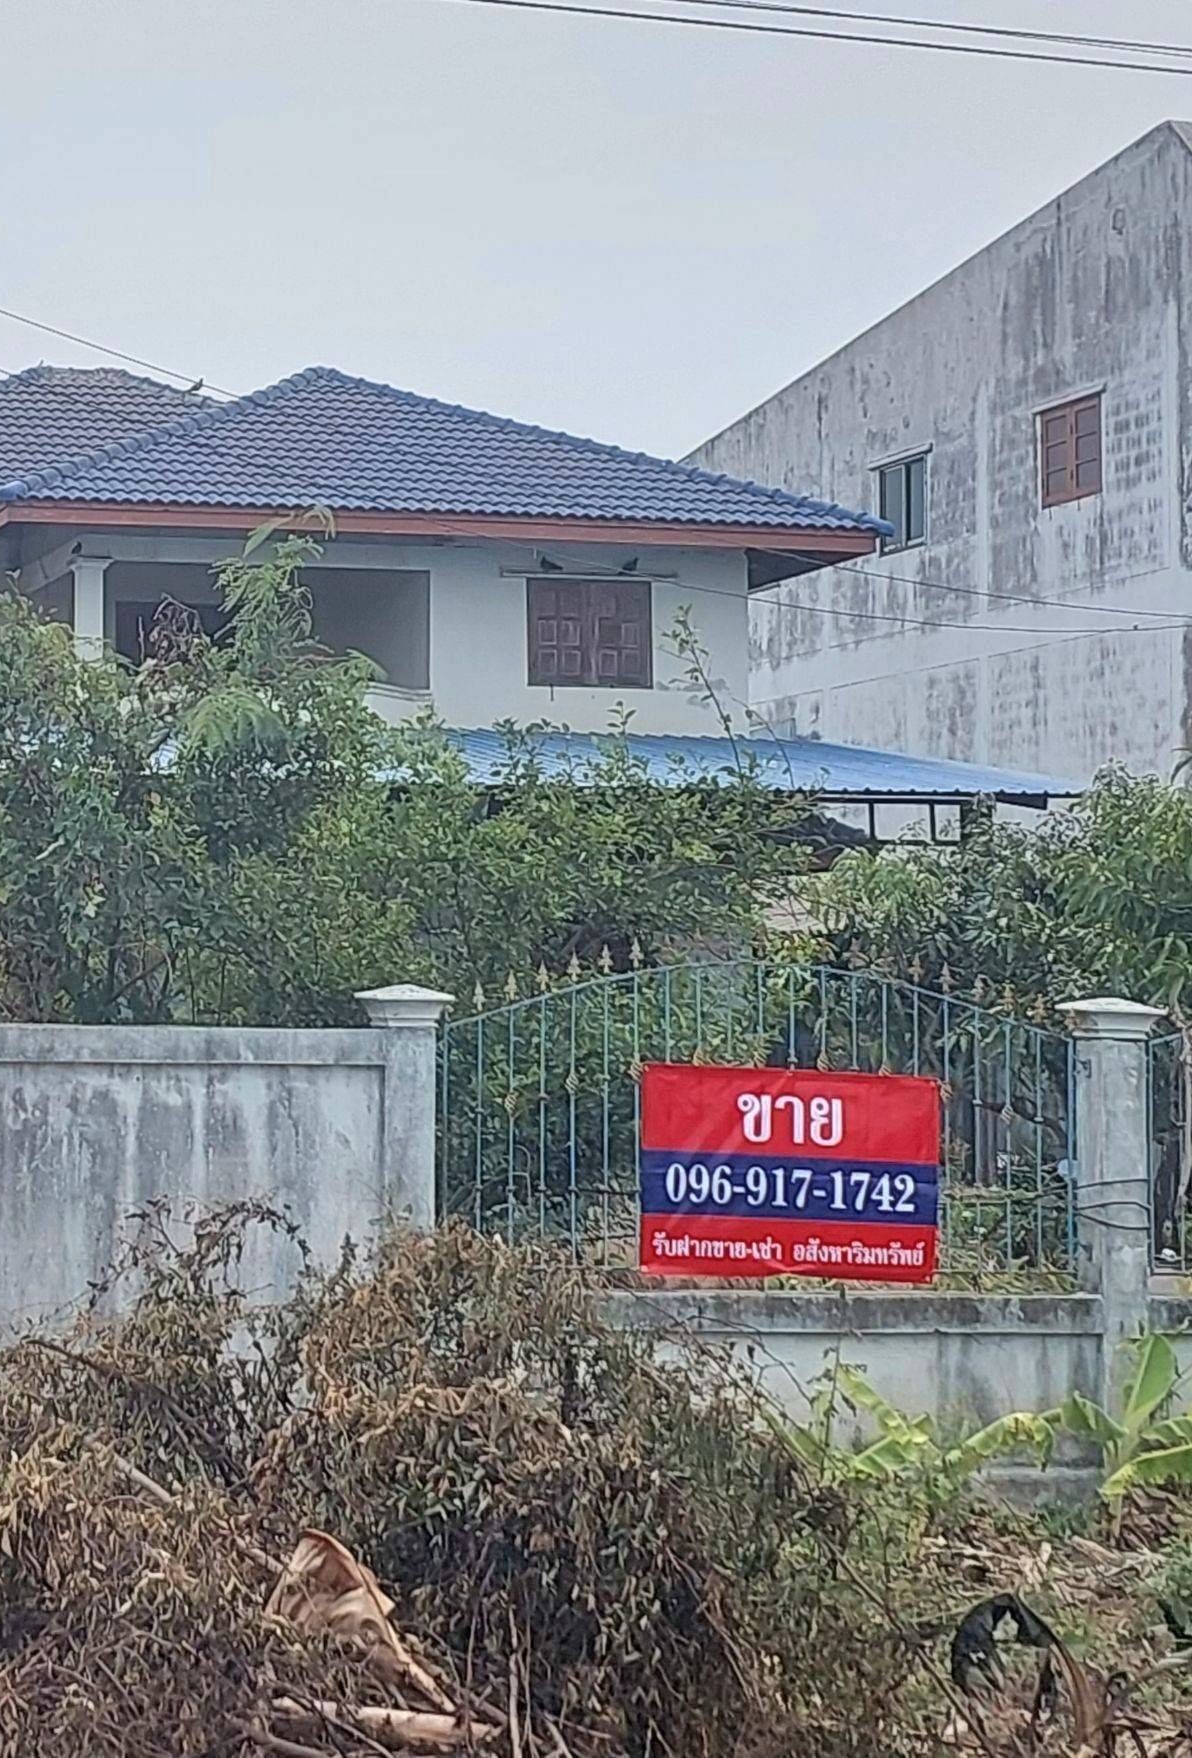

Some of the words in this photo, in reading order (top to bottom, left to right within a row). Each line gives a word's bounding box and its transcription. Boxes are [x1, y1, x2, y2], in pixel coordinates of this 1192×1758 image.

[737, 1093, 843, 1146] ขาย
[665, 1163, 915, 1213] 096-917-1742
[652, 1231, 782, 1261] รับฝากขาย-เช่า
[793, 1237, 926, 1266] อสังหาริมทรัพย์
